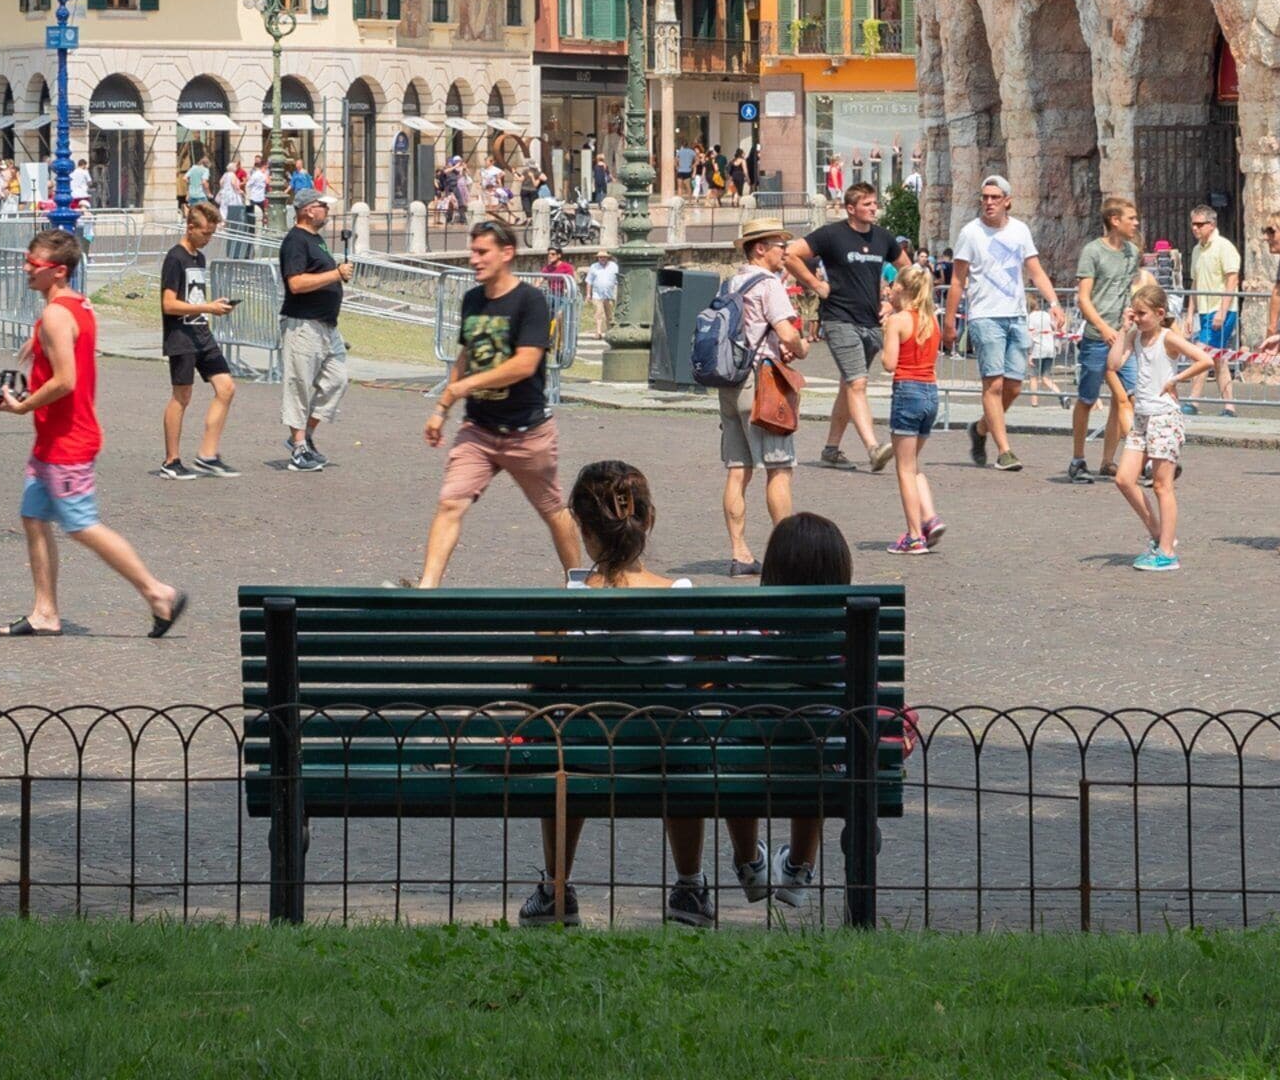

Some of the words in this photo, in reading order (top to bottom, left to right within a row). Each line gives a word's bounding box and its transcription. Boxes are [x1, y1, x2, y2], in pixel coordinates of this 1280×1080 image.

[89, 100, 106, 109] OUIS
[107, 100, 137, 109] VUITTON
[178, 101, 193, 110] OUIS
[194, 101, 224, 110] VUITTON
